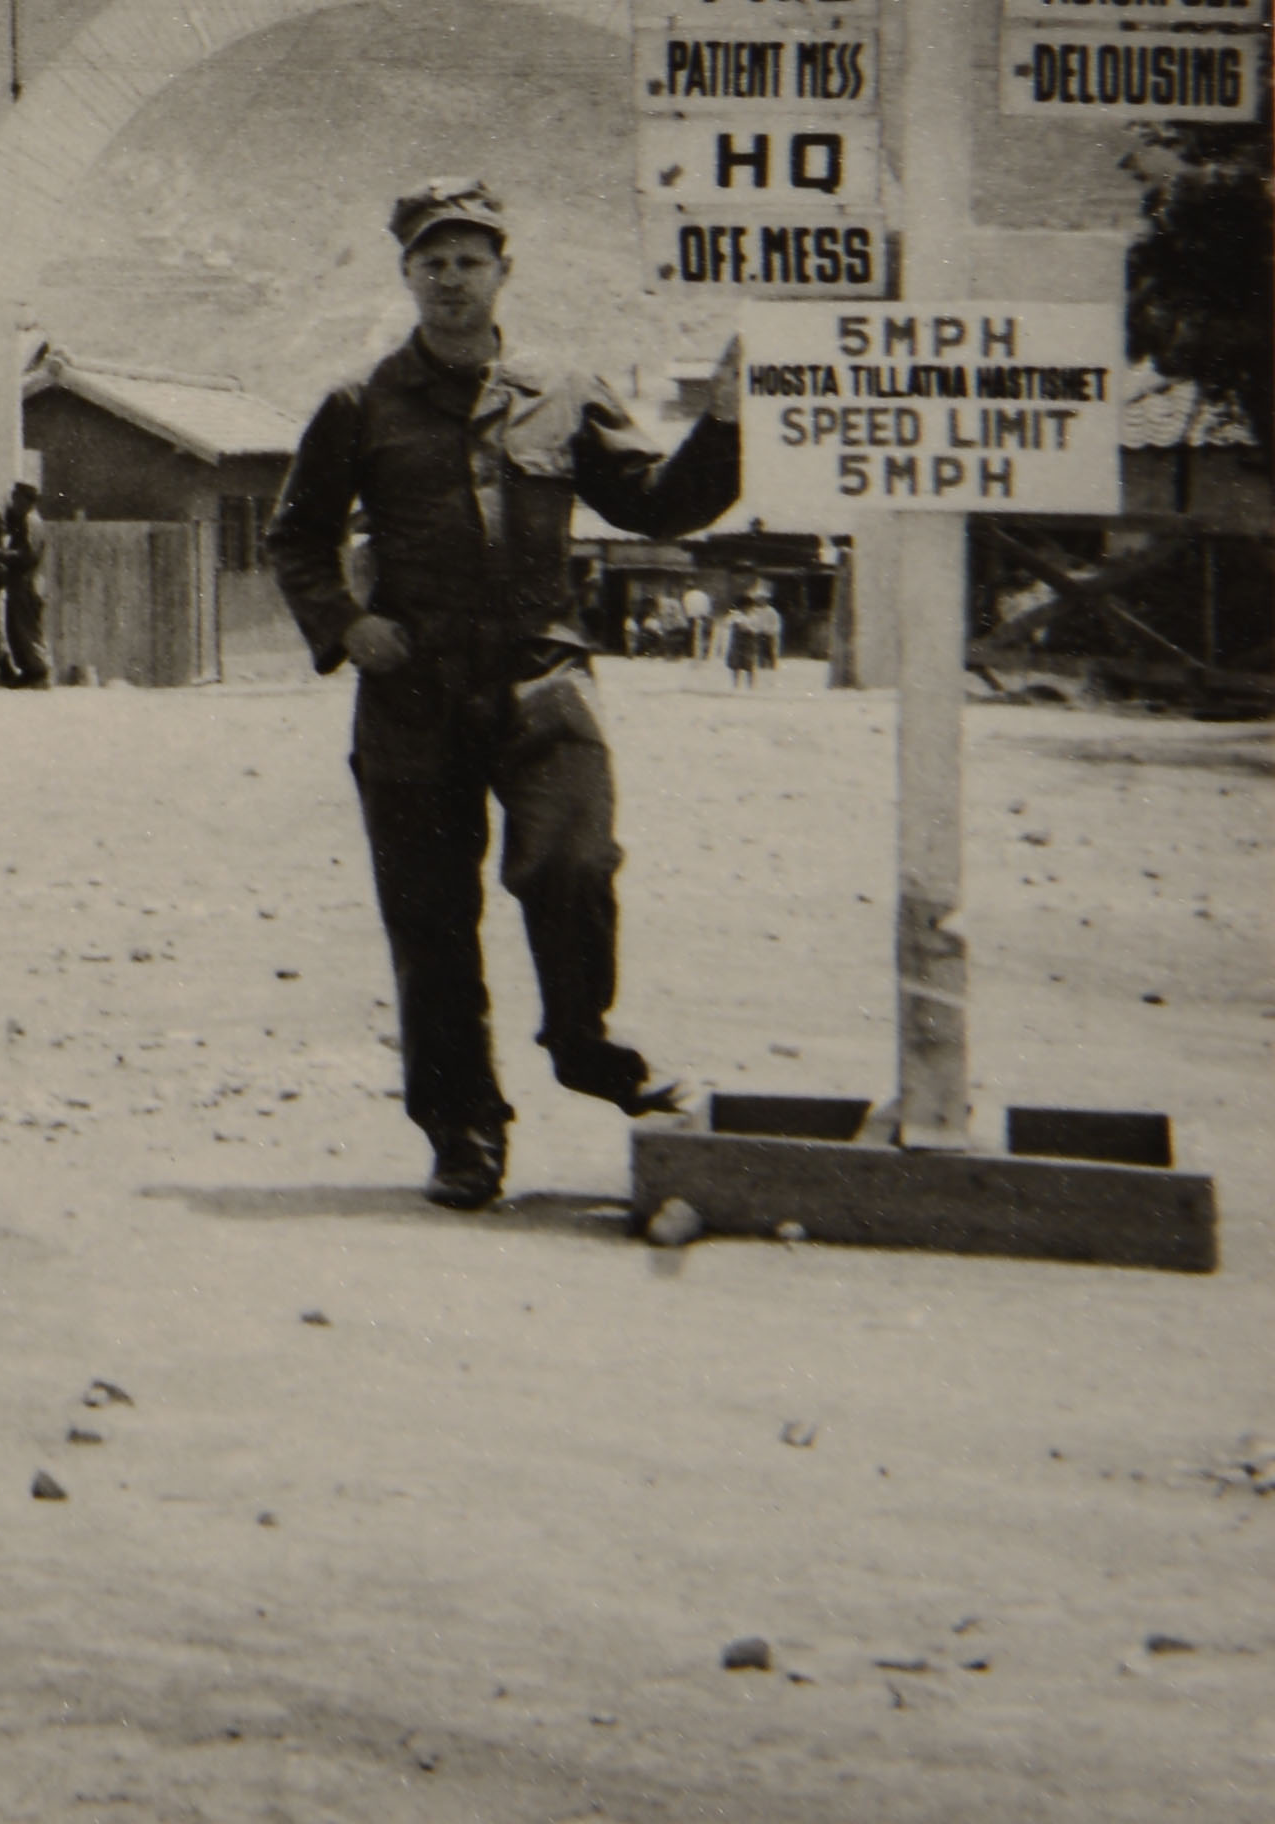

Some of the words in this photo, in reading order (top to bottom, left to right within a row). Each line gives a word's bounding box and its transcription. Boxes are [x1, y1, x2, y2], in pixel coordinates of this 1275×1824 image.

[667, 40, 785, 97] PATIENT
[796, 41, 864, 99] MESS
[1034, 43, 1242, 107] DELOUSING
[716, 133, 843, 194] HQ
[780, 407, 920, 447] SPEED
[950, 408, 1079, 450] LIMIT
